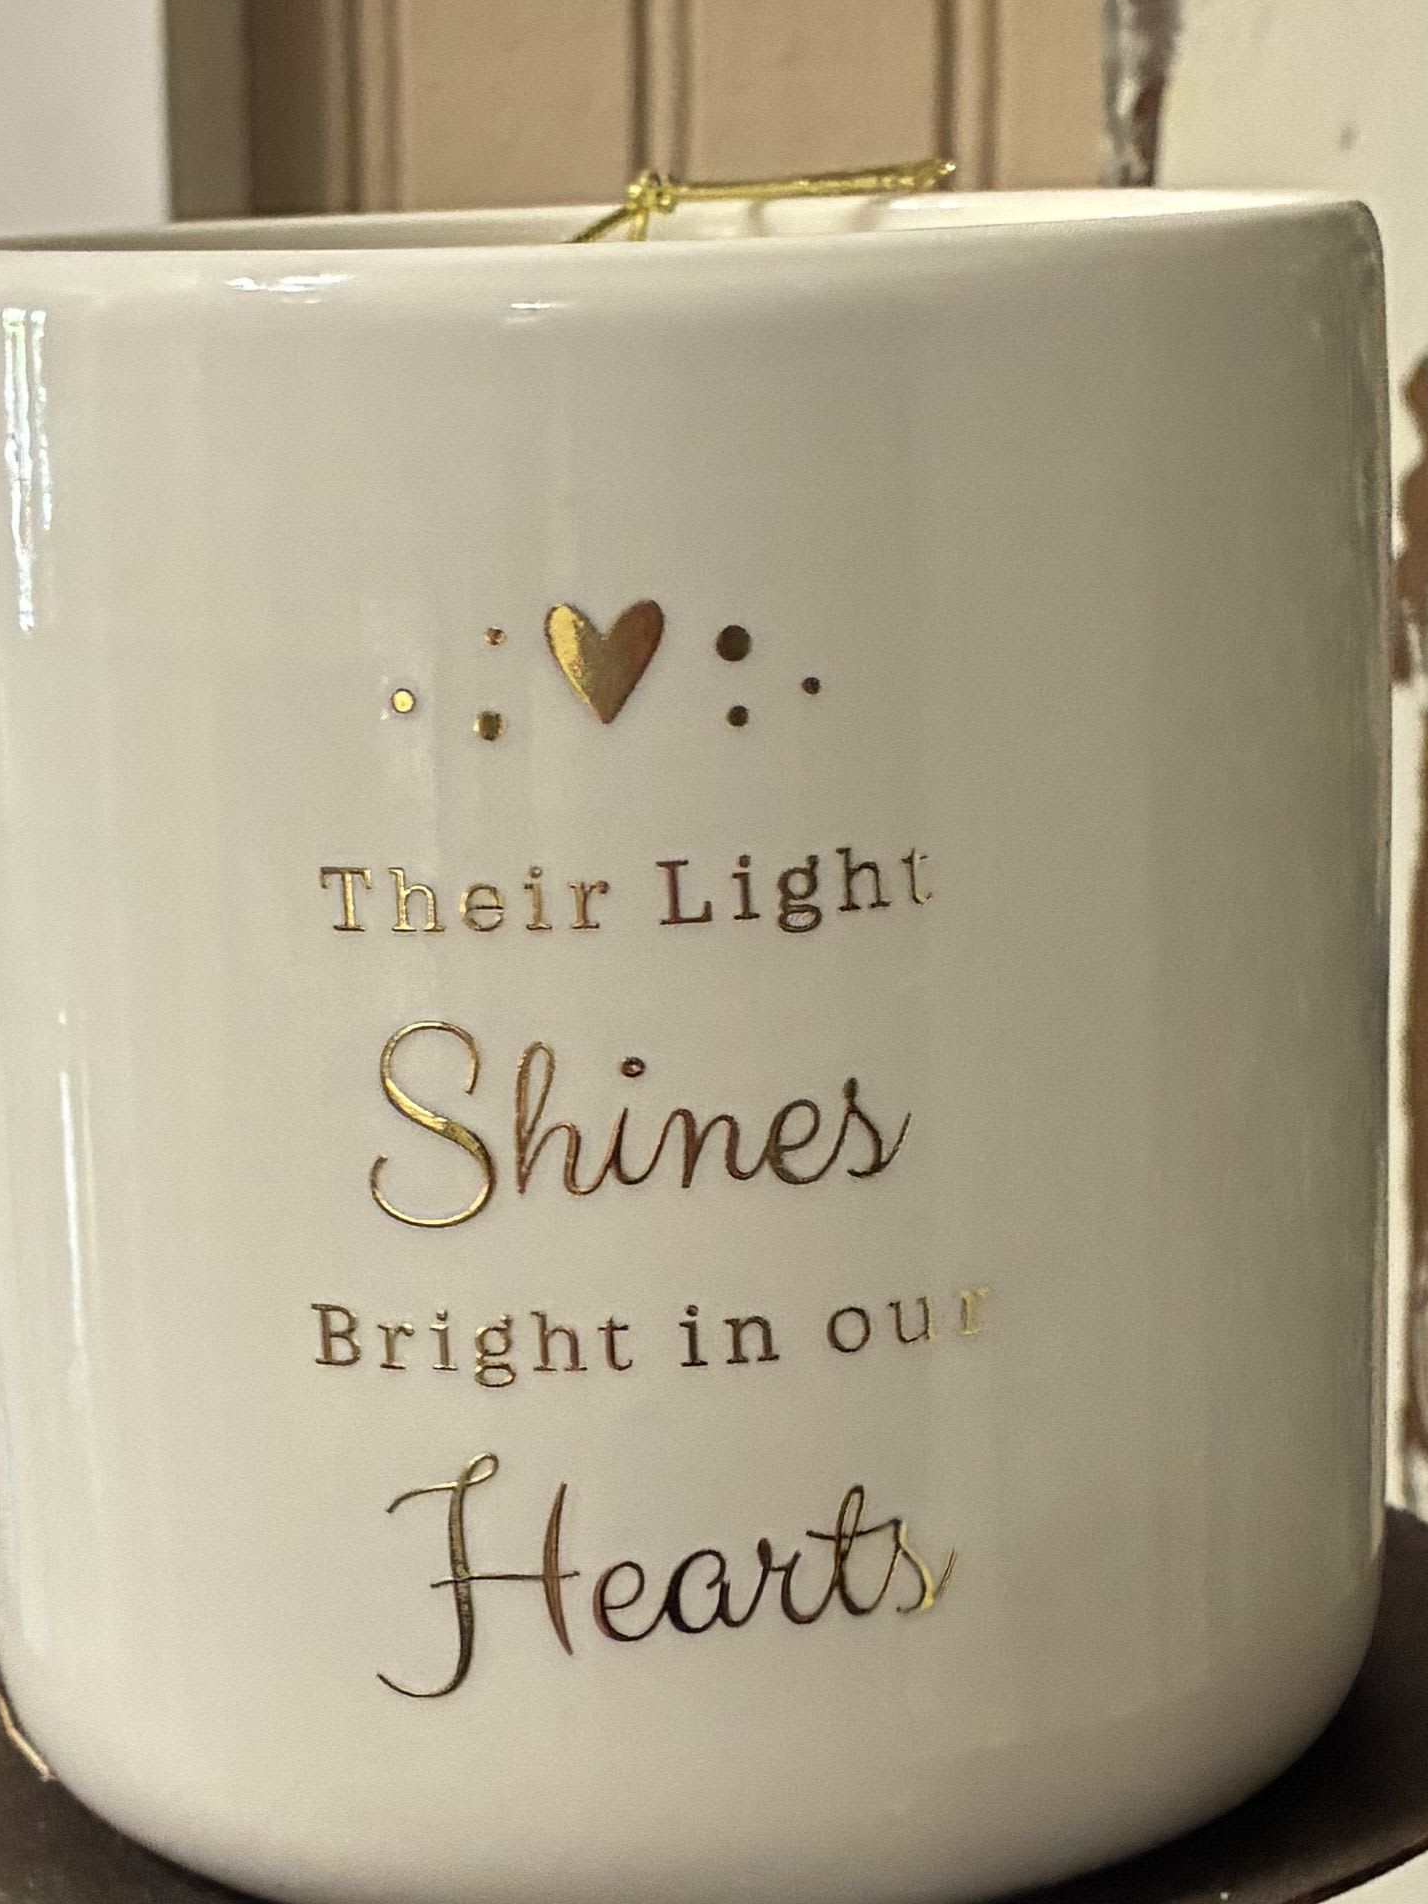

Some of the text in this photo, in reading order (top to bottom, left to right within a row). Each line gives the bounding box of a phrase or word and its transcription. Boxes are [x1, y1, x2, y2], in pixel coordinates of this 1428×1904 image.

[319, 846, 934, 935] Their Light
[369, 1019, 913, 1229] Shines
[310, 1286, 991, 1390] Bright in our
[376, 1451, 959, 1699] Hearts
